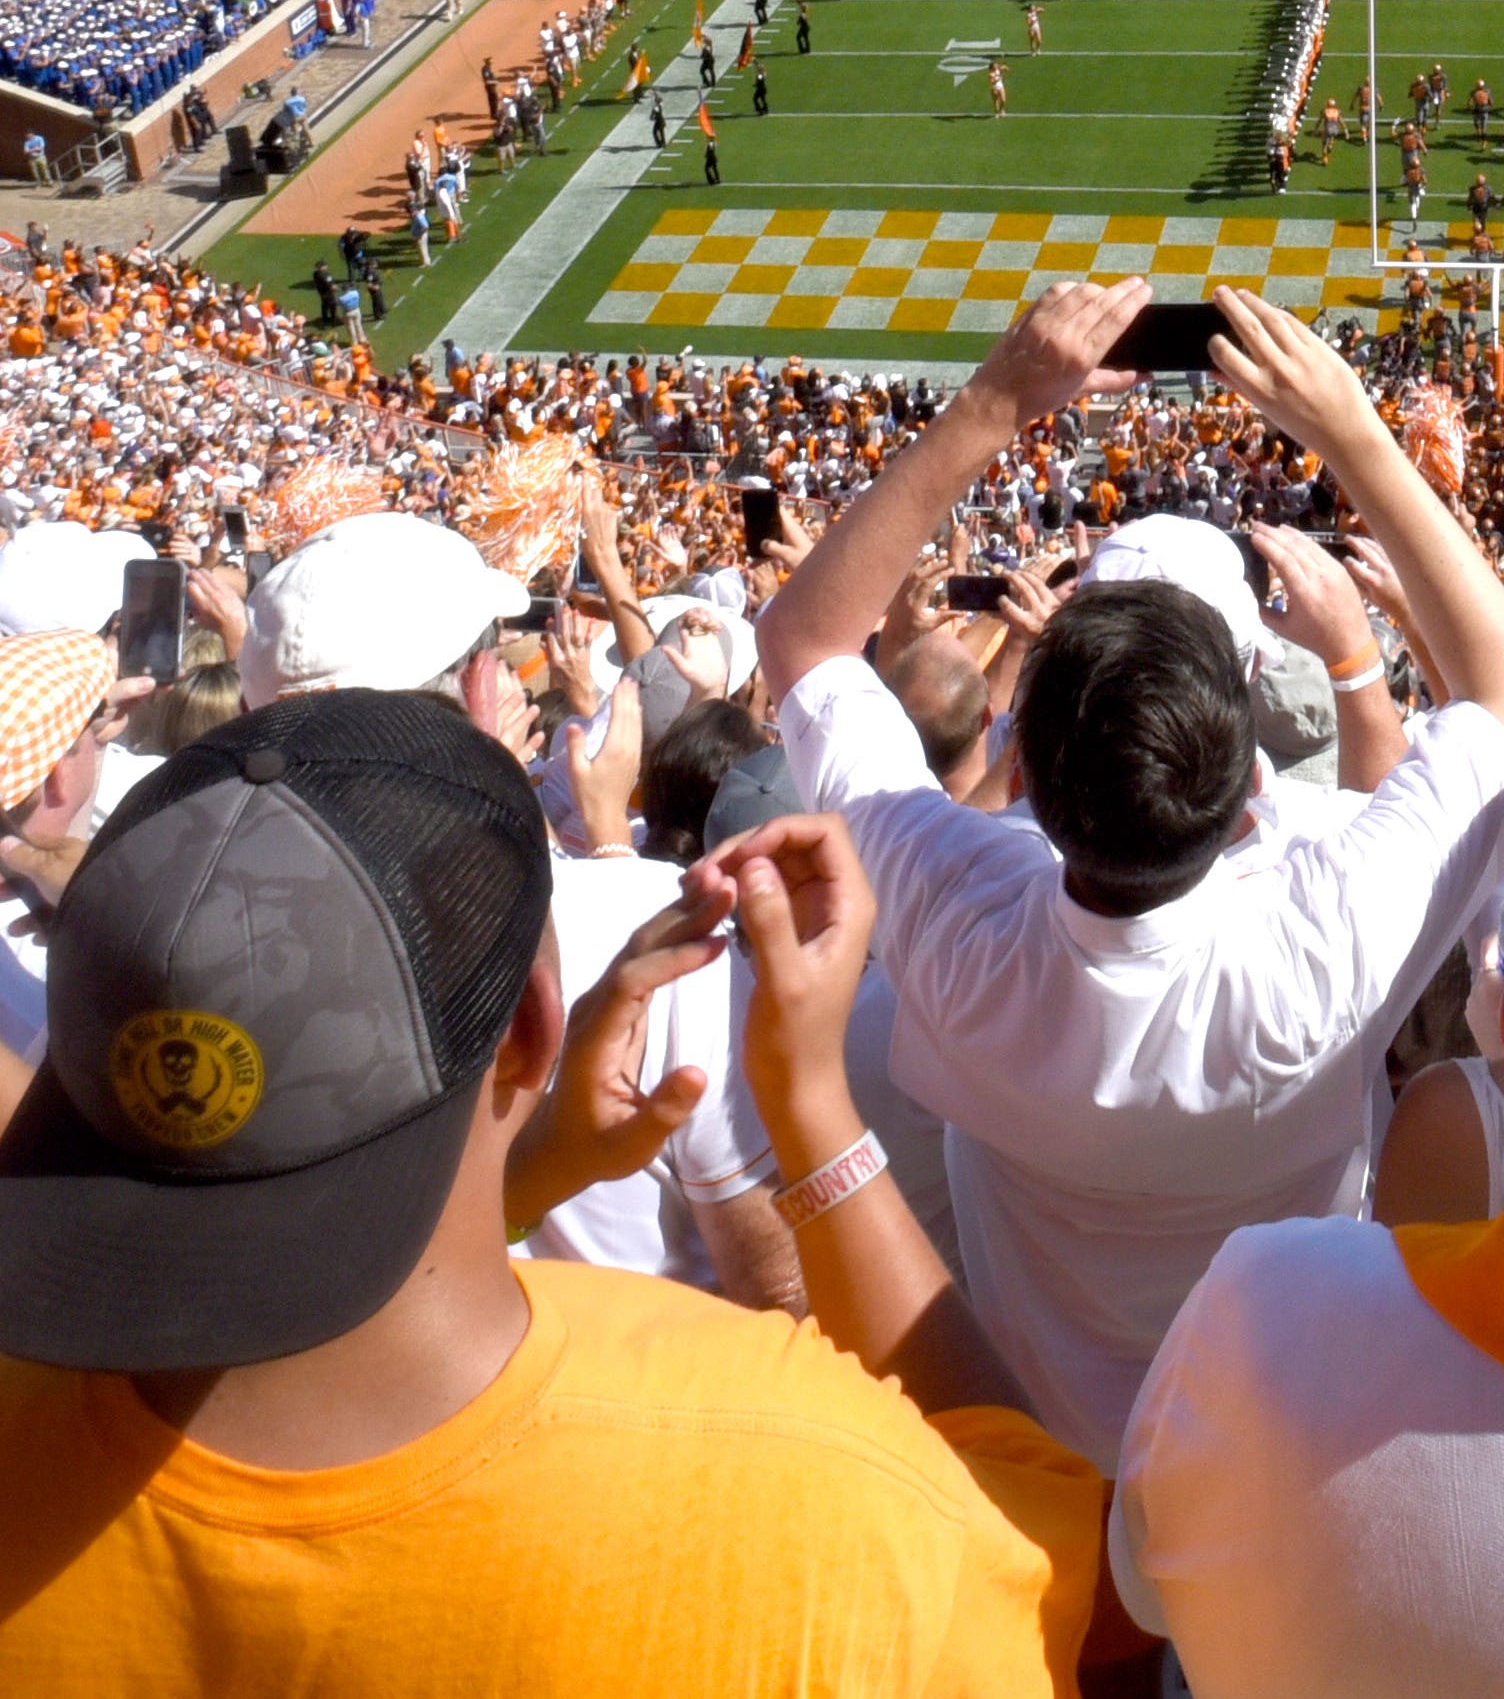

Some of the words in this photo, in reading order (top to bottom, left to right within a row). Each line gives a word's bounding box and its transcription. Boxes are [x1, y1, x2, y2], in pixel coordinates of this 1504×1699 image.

[936, 37, 1002, 75] 10
[190, 1018, 231, 1049] HIGH
[224, 1038, 256, 1088] WATER
